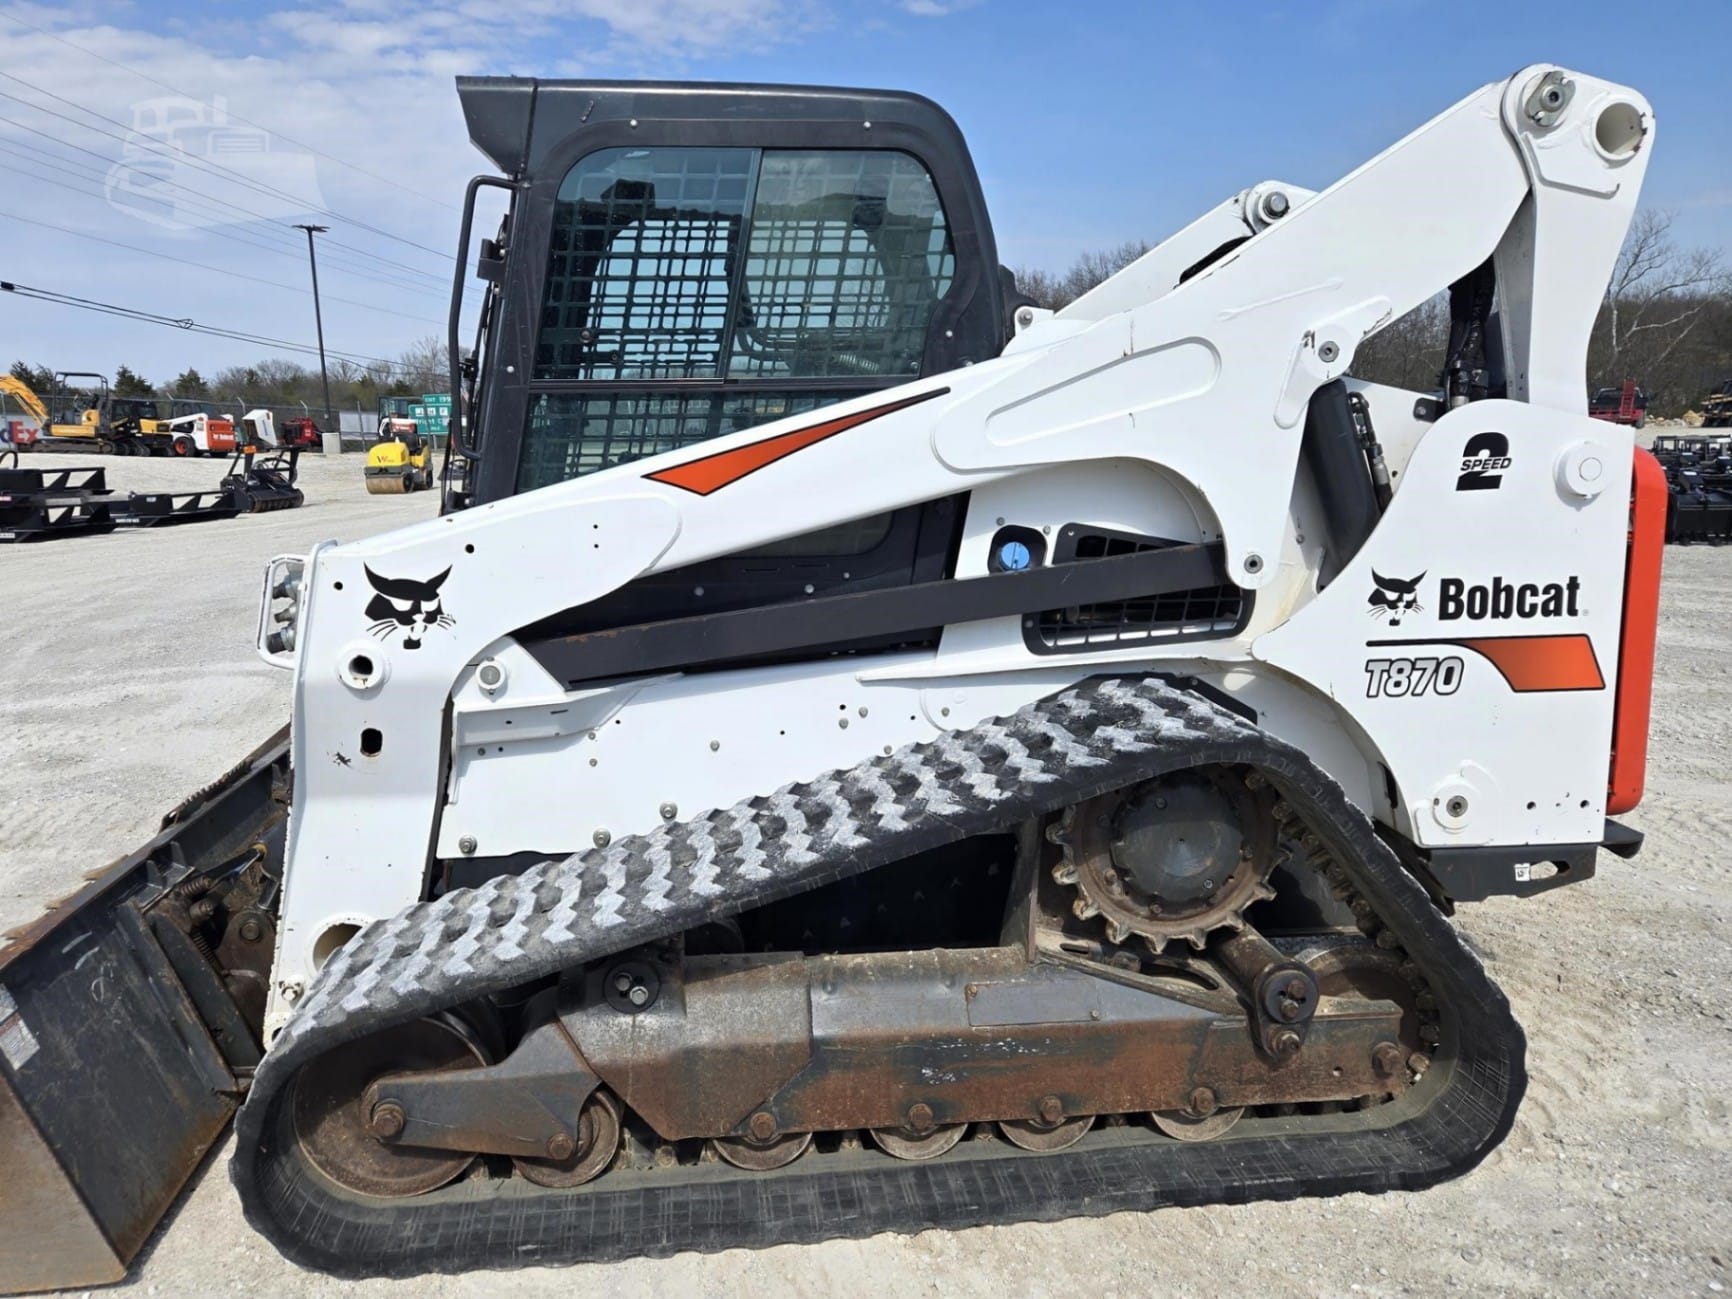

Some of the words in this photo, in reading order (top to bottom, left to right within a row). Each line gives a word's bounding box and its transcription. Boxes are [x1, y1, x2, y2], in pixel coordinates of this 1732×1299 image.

[1456, 432, 1509, 491] 2
[1460, 458, 1512, 471] SPEED
[1438, 576, 1580, 621] Bobcat
[1365, 656, 1464, 698] T870
